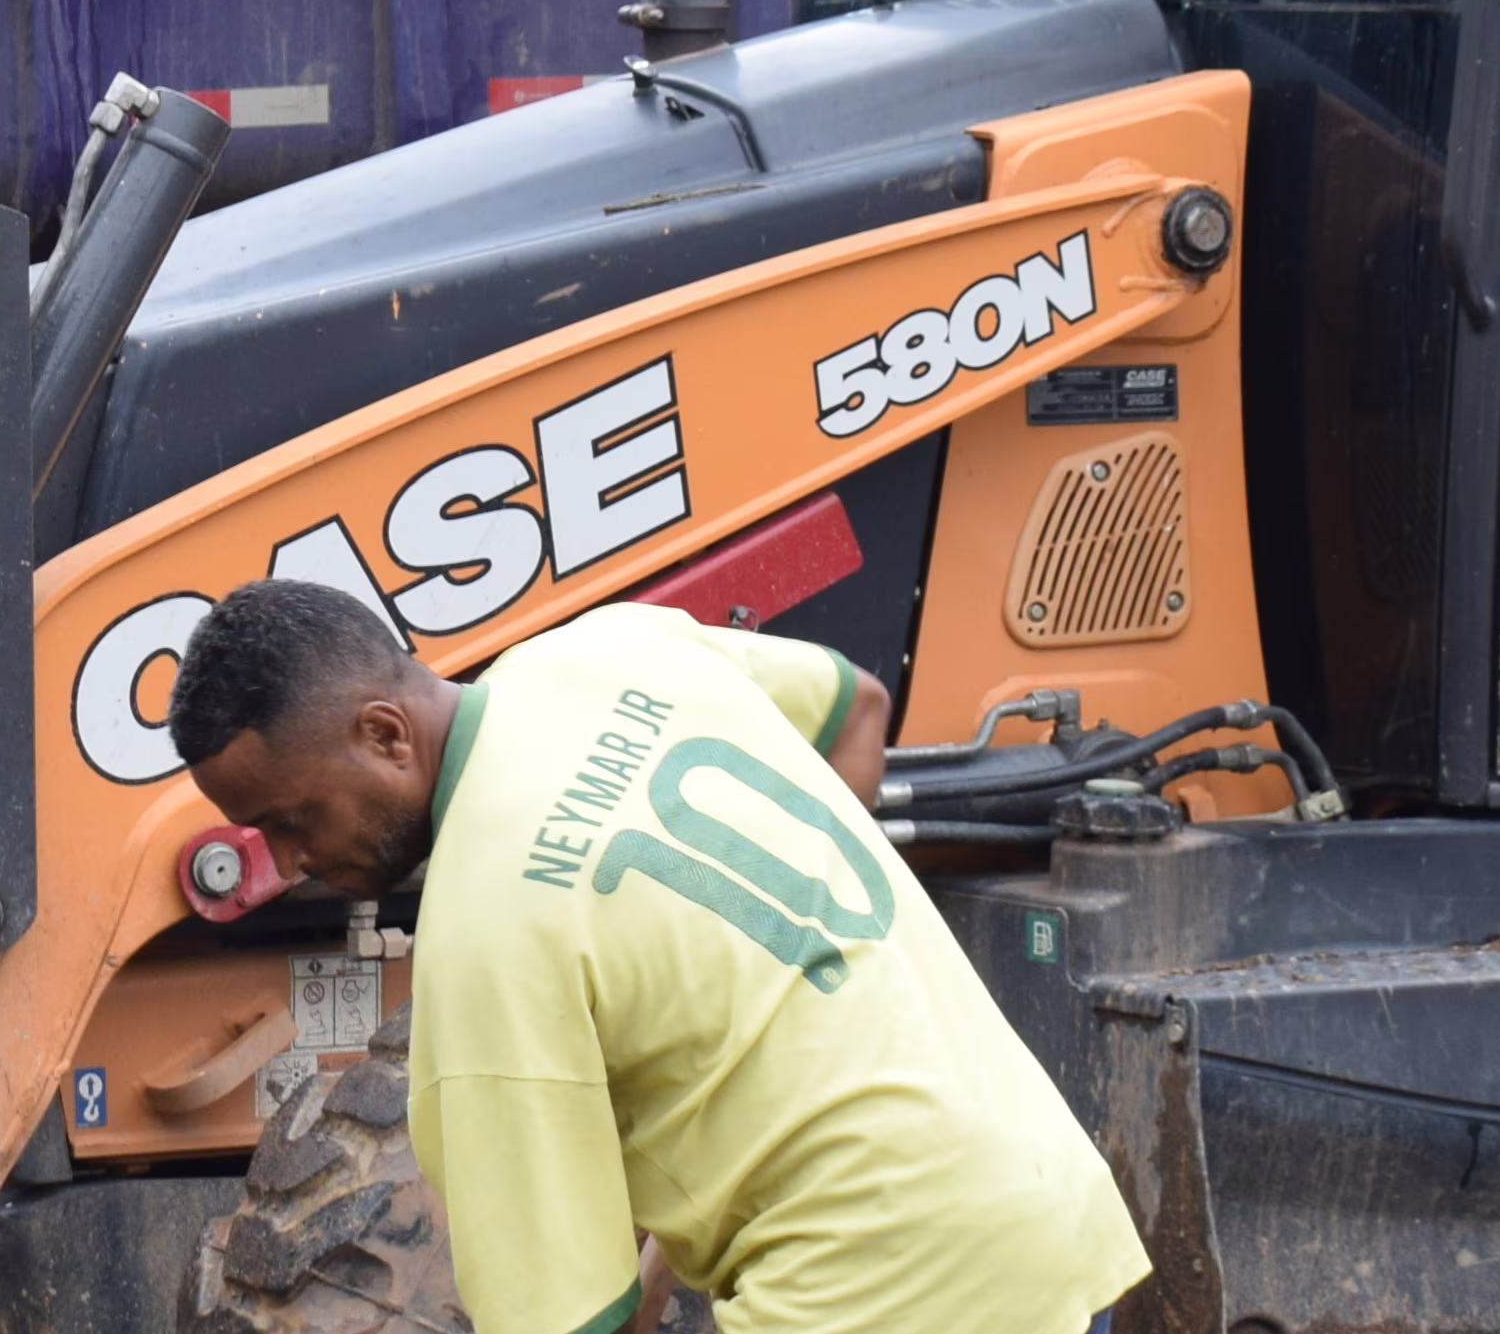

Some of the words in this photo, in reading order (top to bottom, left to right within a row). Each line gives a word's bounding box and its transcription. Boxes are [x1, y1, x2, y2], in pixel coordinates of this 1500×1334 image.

[814, 229, 1098, 438] 580N
[1125, 369, 1167, 381] CASE
[72, 353, 692, 785] CASE
[522, 731, 653, 889] NEYMAR
[613, 688, 675, 737] JR
[592, 736, 895, 994] 10
